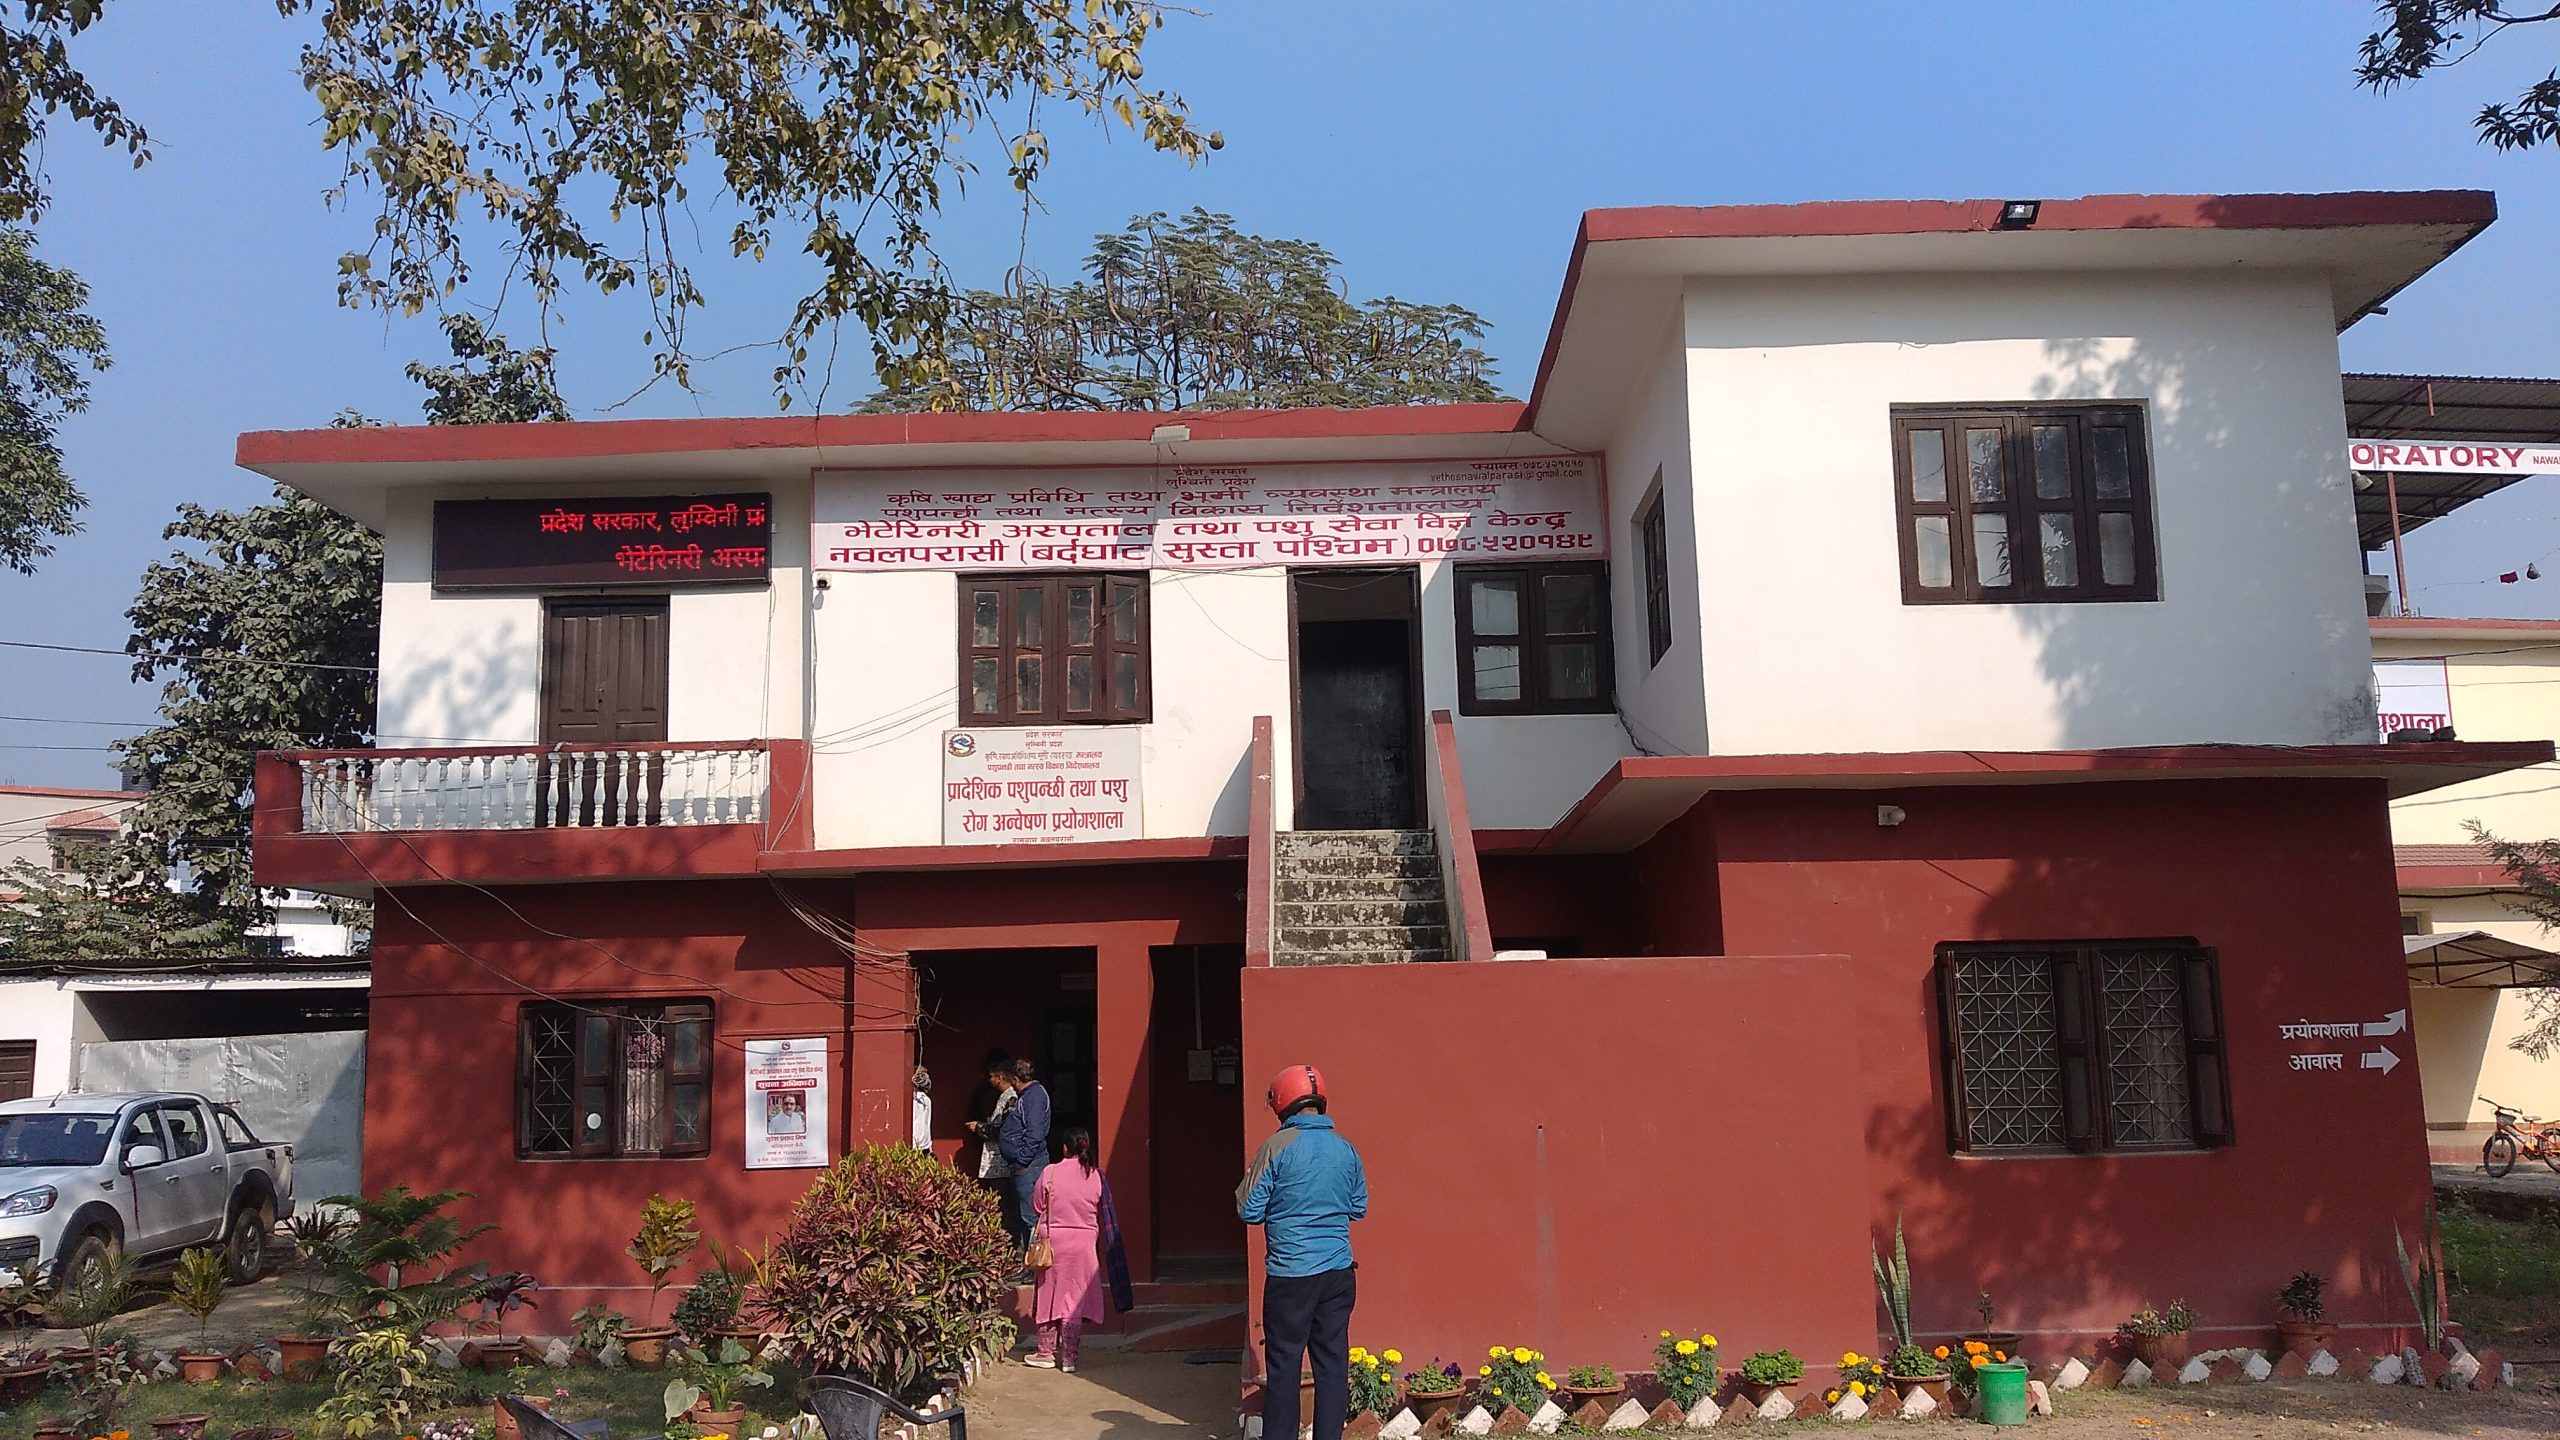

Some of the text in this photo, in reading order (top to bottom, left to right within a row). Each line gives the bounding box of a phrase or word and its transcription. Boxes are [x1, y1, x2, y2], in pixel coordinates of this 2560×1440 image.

[2352, 444, 2526, 467] ORATORY
[1219, 475, 1256, 486] प्रदेश
[941, 493, 996, 504] खाद्य
[1007, 487, 1094, 503] प्रविधि
[1106, 491, 1167, 503] तथा
[1264, 487, 1380, 499] व्यवस्था
[1389, 484, 1501, 497] मन्त्रालय
[540, 508, 586, 532] प्रदेश
[592, 512, 664, 533] सरकार,
[881, 499, 1490, 521] पशुपन्छी तथा मत्स्य विकास निर्देशनालय
[844, 509, 1572, 538] भेटेरिनरी अस्पताल तथा पशु सेवा विज्ञ केन्द्र
[615, 544, 765, 572] भेटेरिनरी अस्प
[830, 539, 1009, 563] नवलपरासी
[1163, 541, 1260, 562] सुस्ता
[947, 776, 1129, 803] प्रादेशिक पशुपन्छी तथा पशु
[962, 807, 1124, 832] रोग अन्वेषण प्रयोगशाला
[2279, 1018, 2359, 1040] प्रयोगशाला
[2288, 1053, 2343, 1071] आवास
